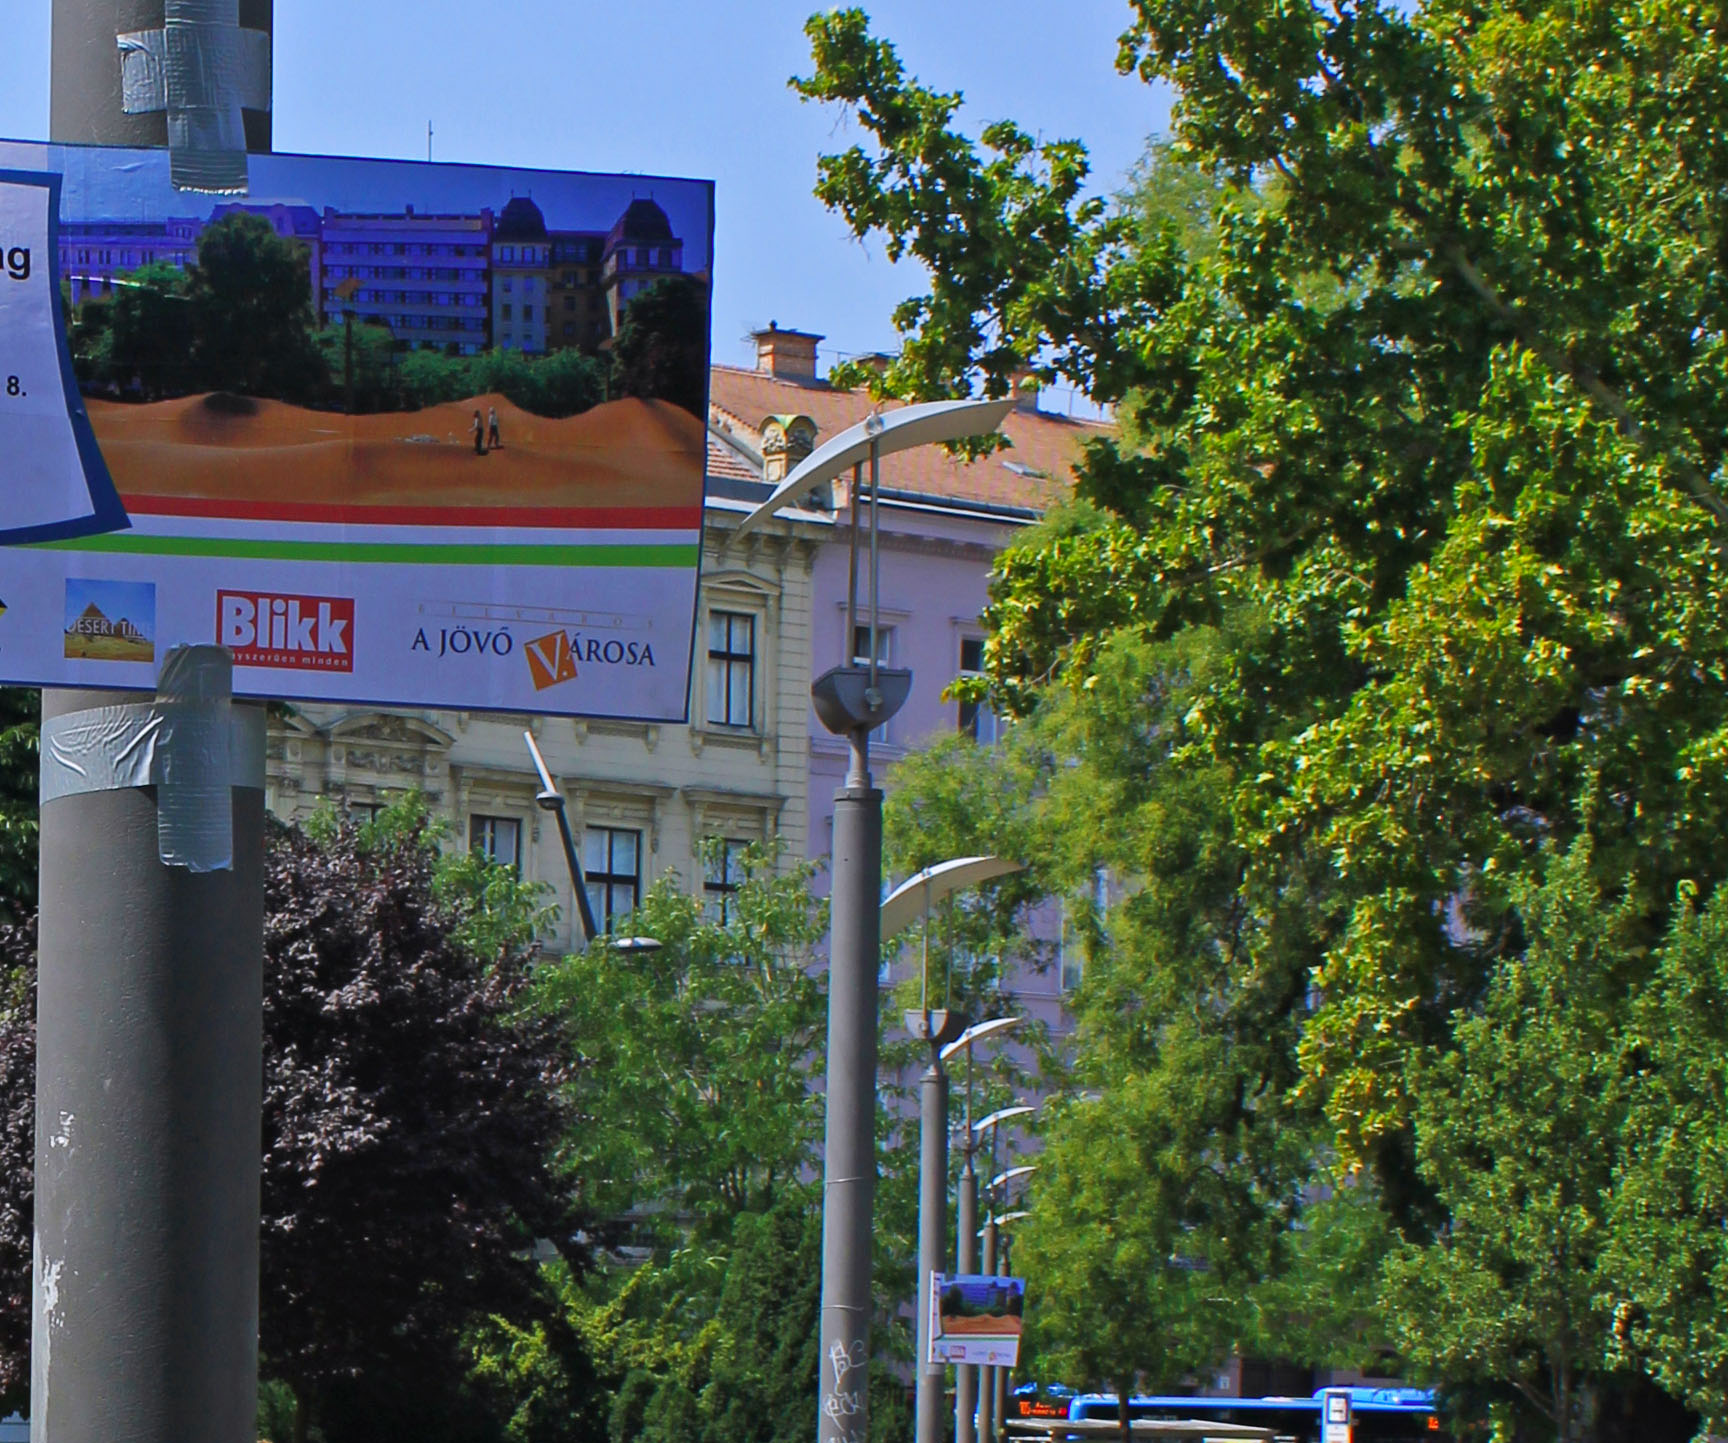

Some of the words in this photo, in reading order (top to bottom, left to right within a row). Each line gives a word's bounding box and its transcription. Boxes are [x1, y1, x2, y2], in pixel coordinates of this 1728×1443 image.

[6, 375, 27, 397] 8.
[222, 596, 348, 653] Blikk
[411, 627, 431, 652] A
